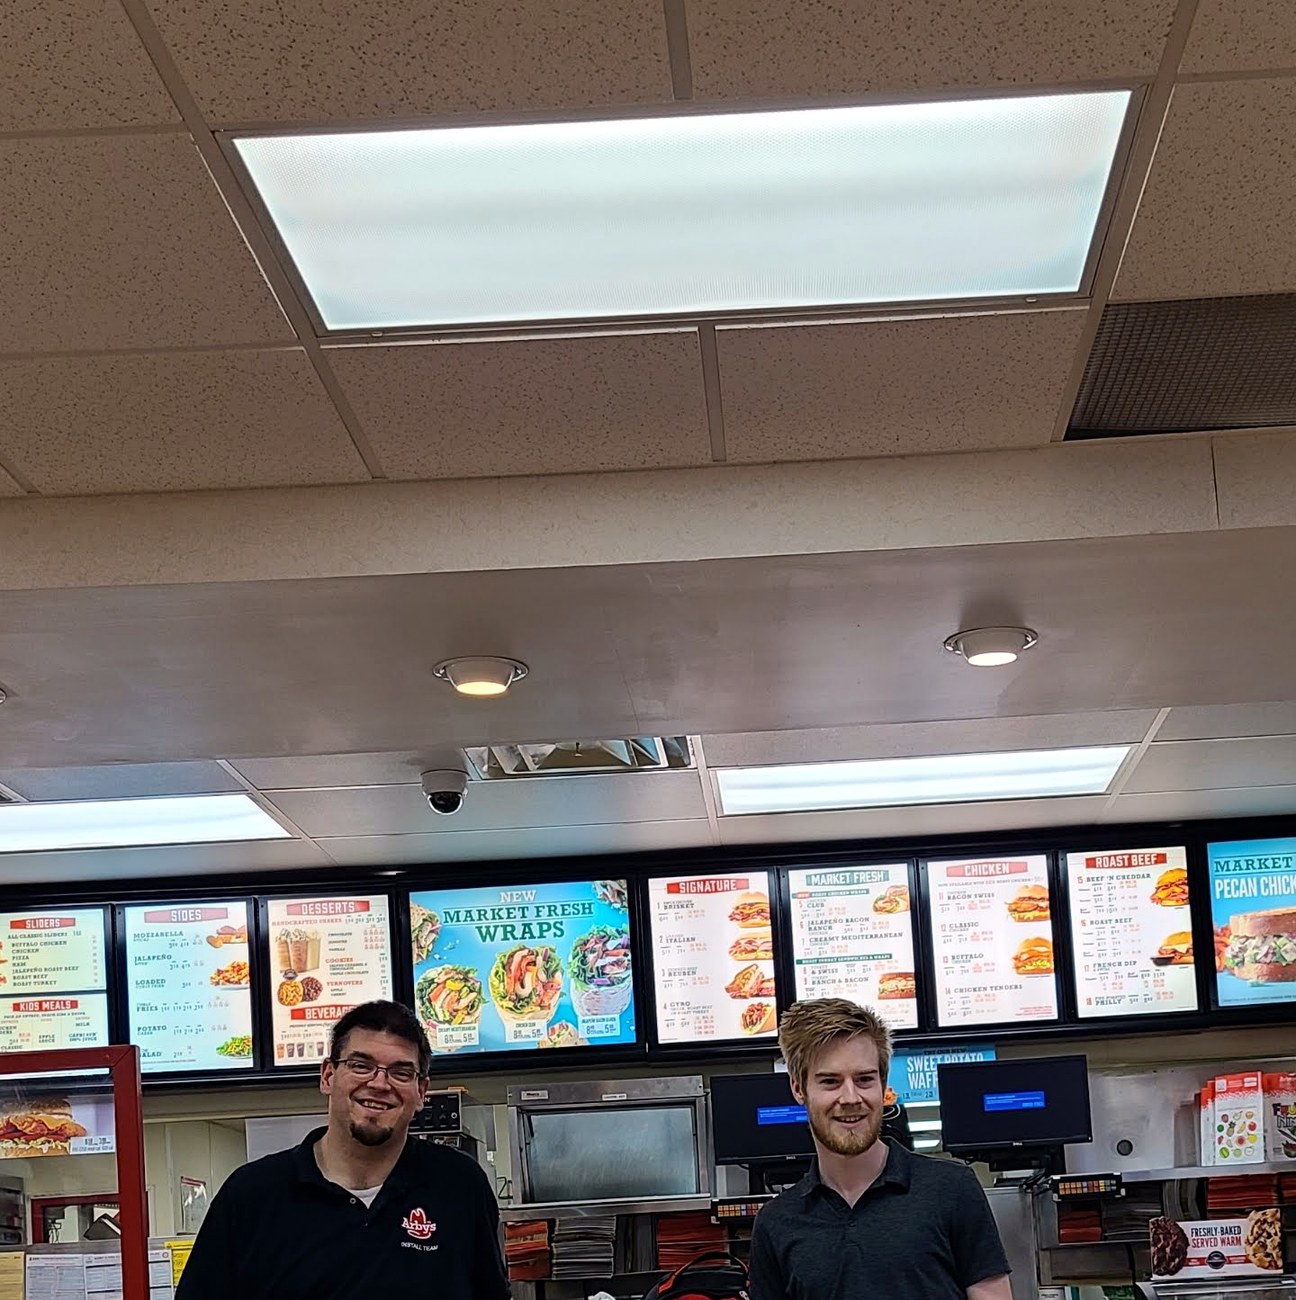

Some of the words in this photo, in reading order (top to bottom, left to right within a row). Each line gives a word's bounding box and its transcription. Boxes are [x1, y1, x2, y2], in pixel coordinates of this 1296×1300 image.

[1096, 853, 1130, 868] ROAST
[1131, 853, 1158, 866] BEEF
[1214, 857, 1292, 872] MARKET
[964, 863, 1010, 876] CHICKEN
[811, 873, 851, 886] MARKET
[853, 871, 884, 883] FRESH
[679, 880, 737, 893] SIGNATURE
[1215, 877, 1258, 899] PECAN
[500, 890, 536, 902] NEW
[301, 902, 355, 914] DESSERTS
[443, 906, 529, 924] MARKET
[534, 902, 594, 918] FRESH
[171, 910, 201, 922] SIDES
[26, 919, 60, 928] SLIDERS
[475, 921, 565, 943] WRAPS
[135, 954, 172, 962] JALAPEÑO
[20, 1002, 39, 1011] KIDS
[42, 1000, 71, 1011] MEALS
[1191, 1226, 1241, 1237] FRESHLY-BAKED
[1192, 1237, 1218, 1248] SERVED
[1220, 1236, 1242, 1247] WARM
